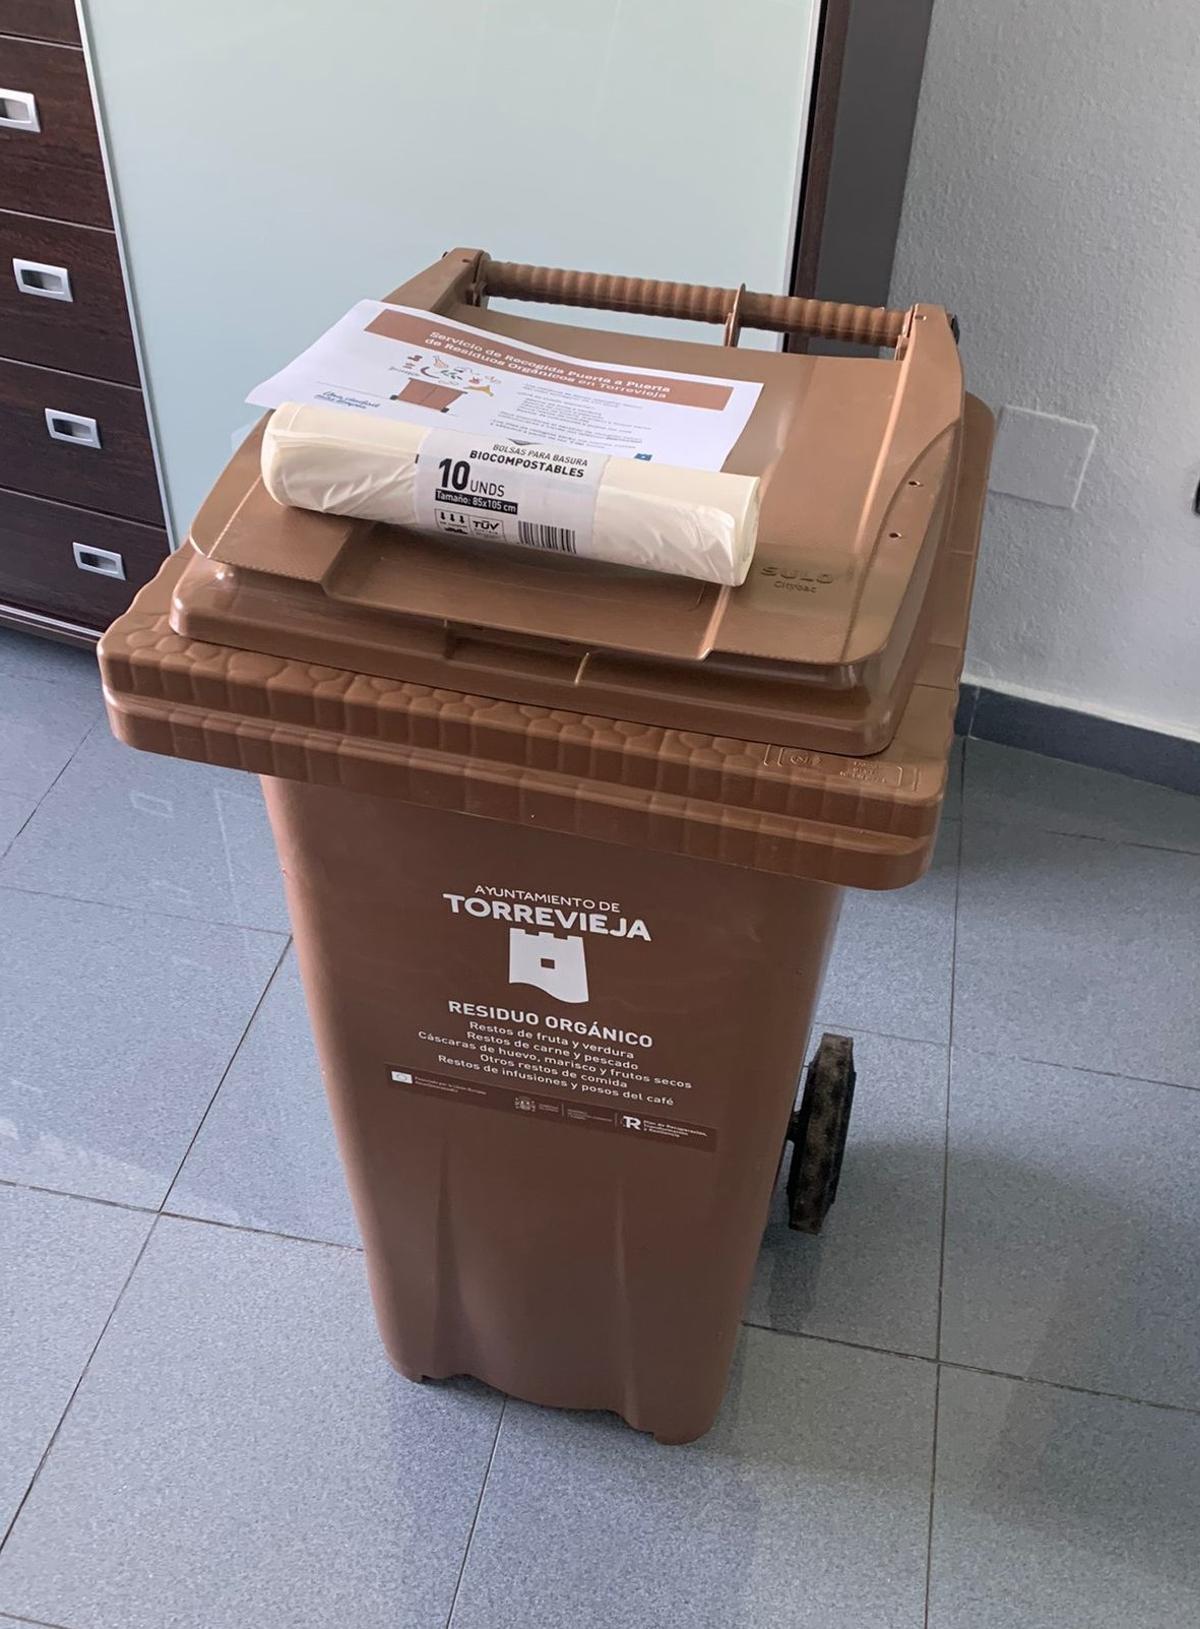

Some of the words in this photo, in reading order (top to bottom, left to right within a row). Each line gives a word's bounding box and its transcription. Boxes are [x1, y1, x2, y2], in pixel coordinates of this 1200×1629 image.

[425, 338, 442, 347] de
[444, 343, 506, 366] Residuos
[508, 362, 575, 383] Orgánicos
[599, 383, 667, 398] Torrevieja
[429, 331, 483, 352] Servicio
[485, 348, 502, 358] de
[505, 354, 564, 374] Recogida
[568, 369, 611, 384] Puerta
[626, 380, 671, 393] Puerta
[470, 450, 585, 478] BIOCOMPOSTABLES
[492, 444, 526, 456] BOLSAS
[528, 450, 551, 461] PARA
[553, 454, 588, 467] BASURA
[438, 458, 471, 490] 10
[470, 480, 505, 497] UNDS
[437, 490, 471, 505] Tamaño:
[472, 497, 501, 511] 85x105
[503, 503, 516, 513] cm
[473, 520, 500, 531] TÜV
[443, 893, 652, 942] TORREVIEJA
[475, 885, 596, 909] AYUNTAMIENTO
[599, 901, 621, 913] DE
[448, 1000, 539, 1025] RESIDUO
[545, 1016, 653, 1048] ORGÁNICO
[469, 1021, 514, 1036] Restos
[517, 1028, 533, 1039] de
[537, 1032, 569, 1045] fruta
[572, 1041, 580, 1049] y
[582, 1042, 635, 1059] verdura
[418, 1031, 476, 1050] Cáscaras
[479, 1044, 495, 1054] de
[498, 1046, 541, 1063] huevo,
[544, 1056, 597, 1073] marisco
[600, 1067, 607, 1076] y
[610, 1068, 651, 1082] frutos
[654, 1077, 692, 1089] secos
[467, 1031, 511, 1046] Restos
[514, 1038, 530, 1049] de
[533, 1045, 570, 1057] carne
[573, 1051, 581, 1060] y
[584, 1053, 639, 1070] pescado
[438, 1054, 481, 1071] Restos
[483, 1064, 499, 1074] de
[502, 1067, 568, 1087] infusiones
[571, 1081, 578, 1090] y
[581, 1084, 620, 1097] posos
[622, 1090, 643, 1101] del
[646, 1095, 674, 1106] café
[480, 1054, 515, 1067] Otros
[518, 1062, 558, 1076] restos
[561, 1069, 577, 1079] de
[581, 1074, 628, 1089] comida
